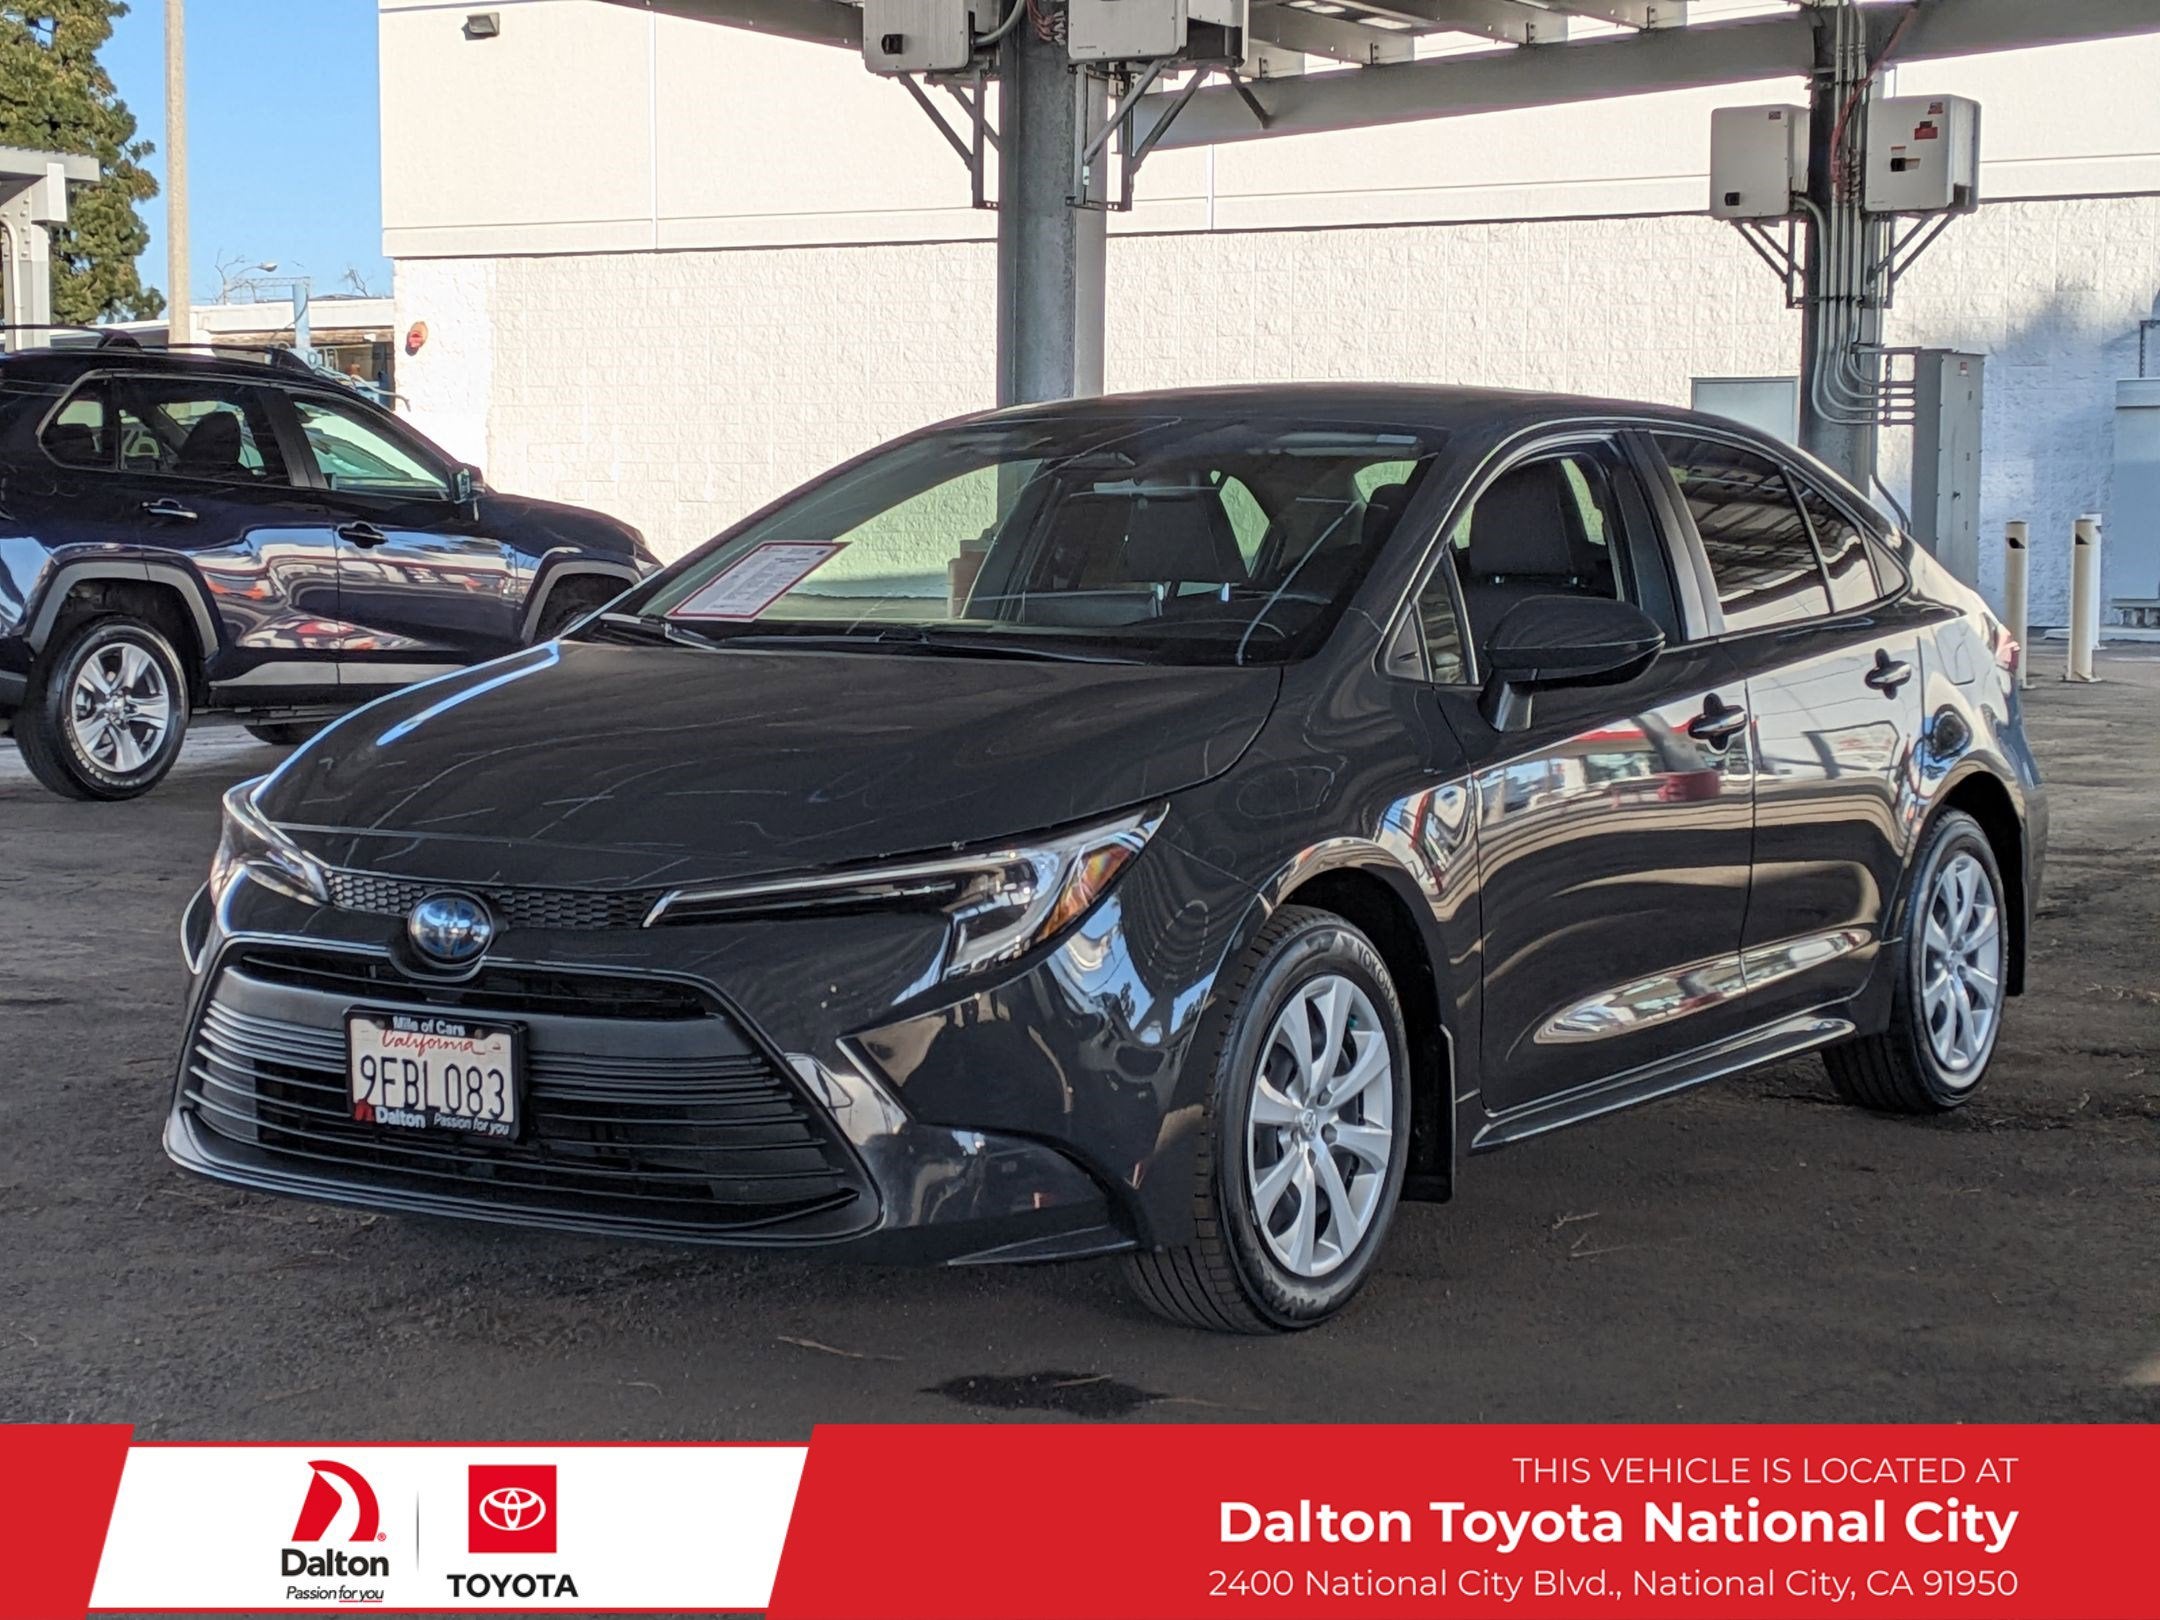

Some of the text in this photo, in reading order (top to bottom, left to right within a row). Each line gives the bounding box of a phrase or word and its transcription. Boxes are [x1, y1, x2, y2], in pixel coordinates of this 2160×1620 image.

[392, 1015, 466, 1037] Mile of Cars
[381, 1028, 486, 1057] California
[375, 1106, 426, 1129] Dalton
[434, 1112, 510, 1136] Passion for you
